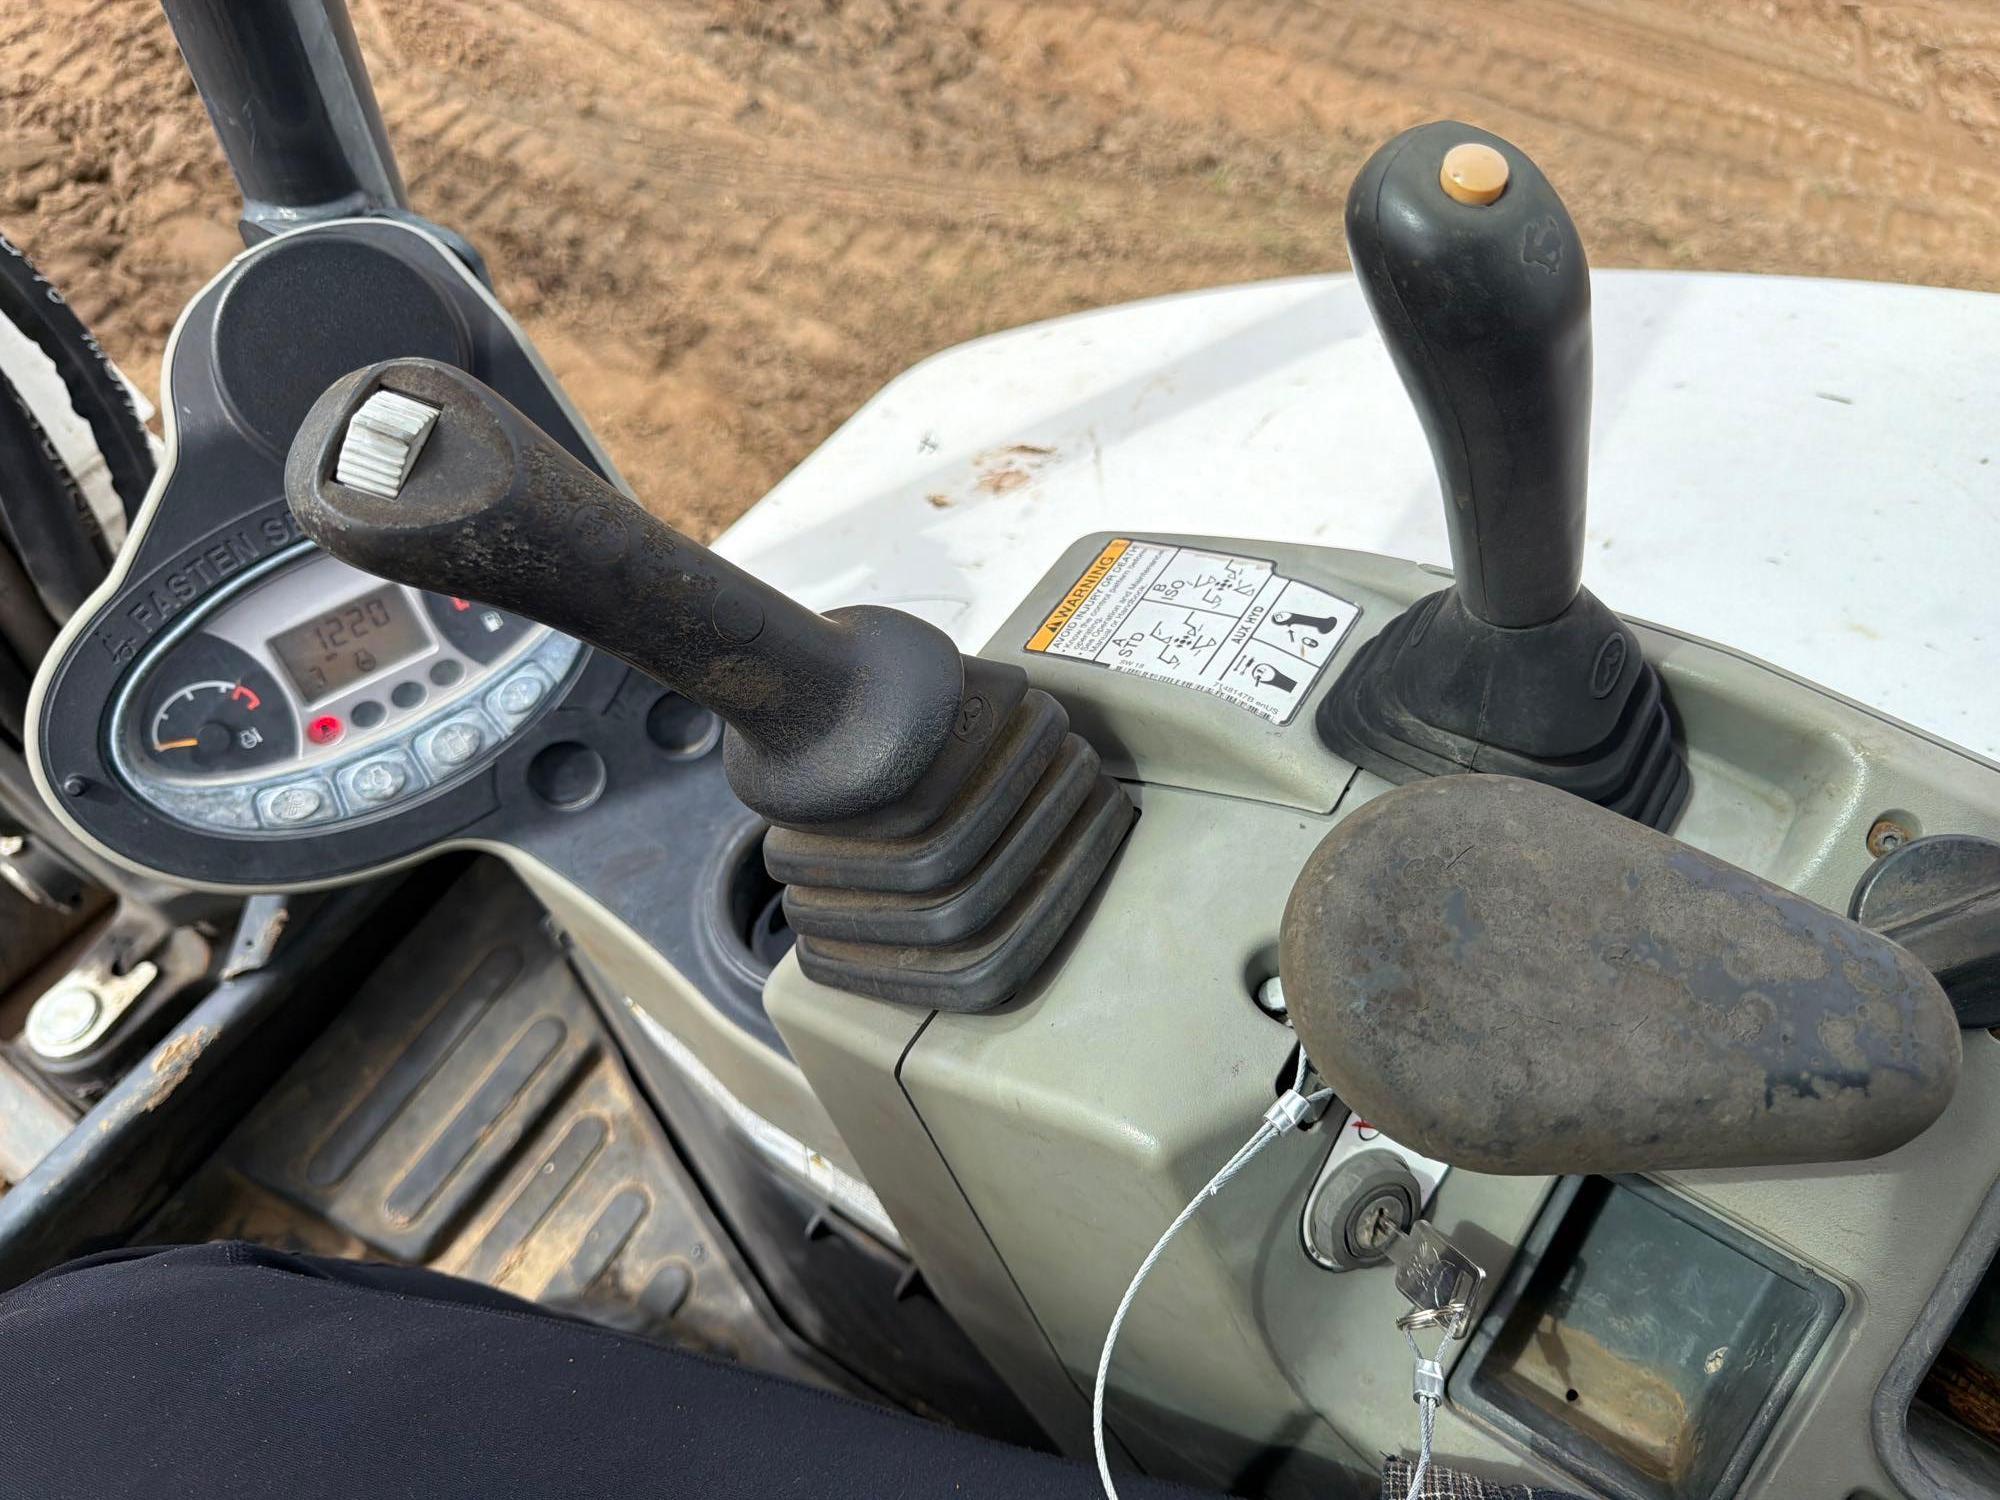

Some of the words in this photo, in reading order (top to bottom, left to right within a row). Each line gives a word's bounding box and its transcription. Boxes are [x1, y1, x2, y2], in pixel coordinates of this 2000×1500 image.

[127, 533, 260, 633] FASTEN
[1051, 621, 1078, 648] AVOID
[1073, 588, 1104, 620] INJURY
[1099, 574, 1116, 587] OR
[1111, 545, 1139, 573] DEATH
[1053, 555, 1115, 619] WARNING
[1153, 583, 1167, 592] B
[1161, 580, 1185, 600] ISO
[315, 599, 391, 649] 1220
[1063, 629, 1083, 648] Know
[1080, 617, 1093, 628] the
[1089, 593, 1111, 616] control
[1108, 569, 1131, 592] pattern
[1079, 637, 1095, 651] See
[1090, 604, 1122, 637] Operation
[1117, 591, 1132, 603] and
[1231, 625, 1252, 644] AUX
[1245, 606, 1264, 624] HYD
[1089, 628, 1112, 652] Manual
[1112, 638, 1126, 647] A
[1118, 632, 1145, 657] STD
